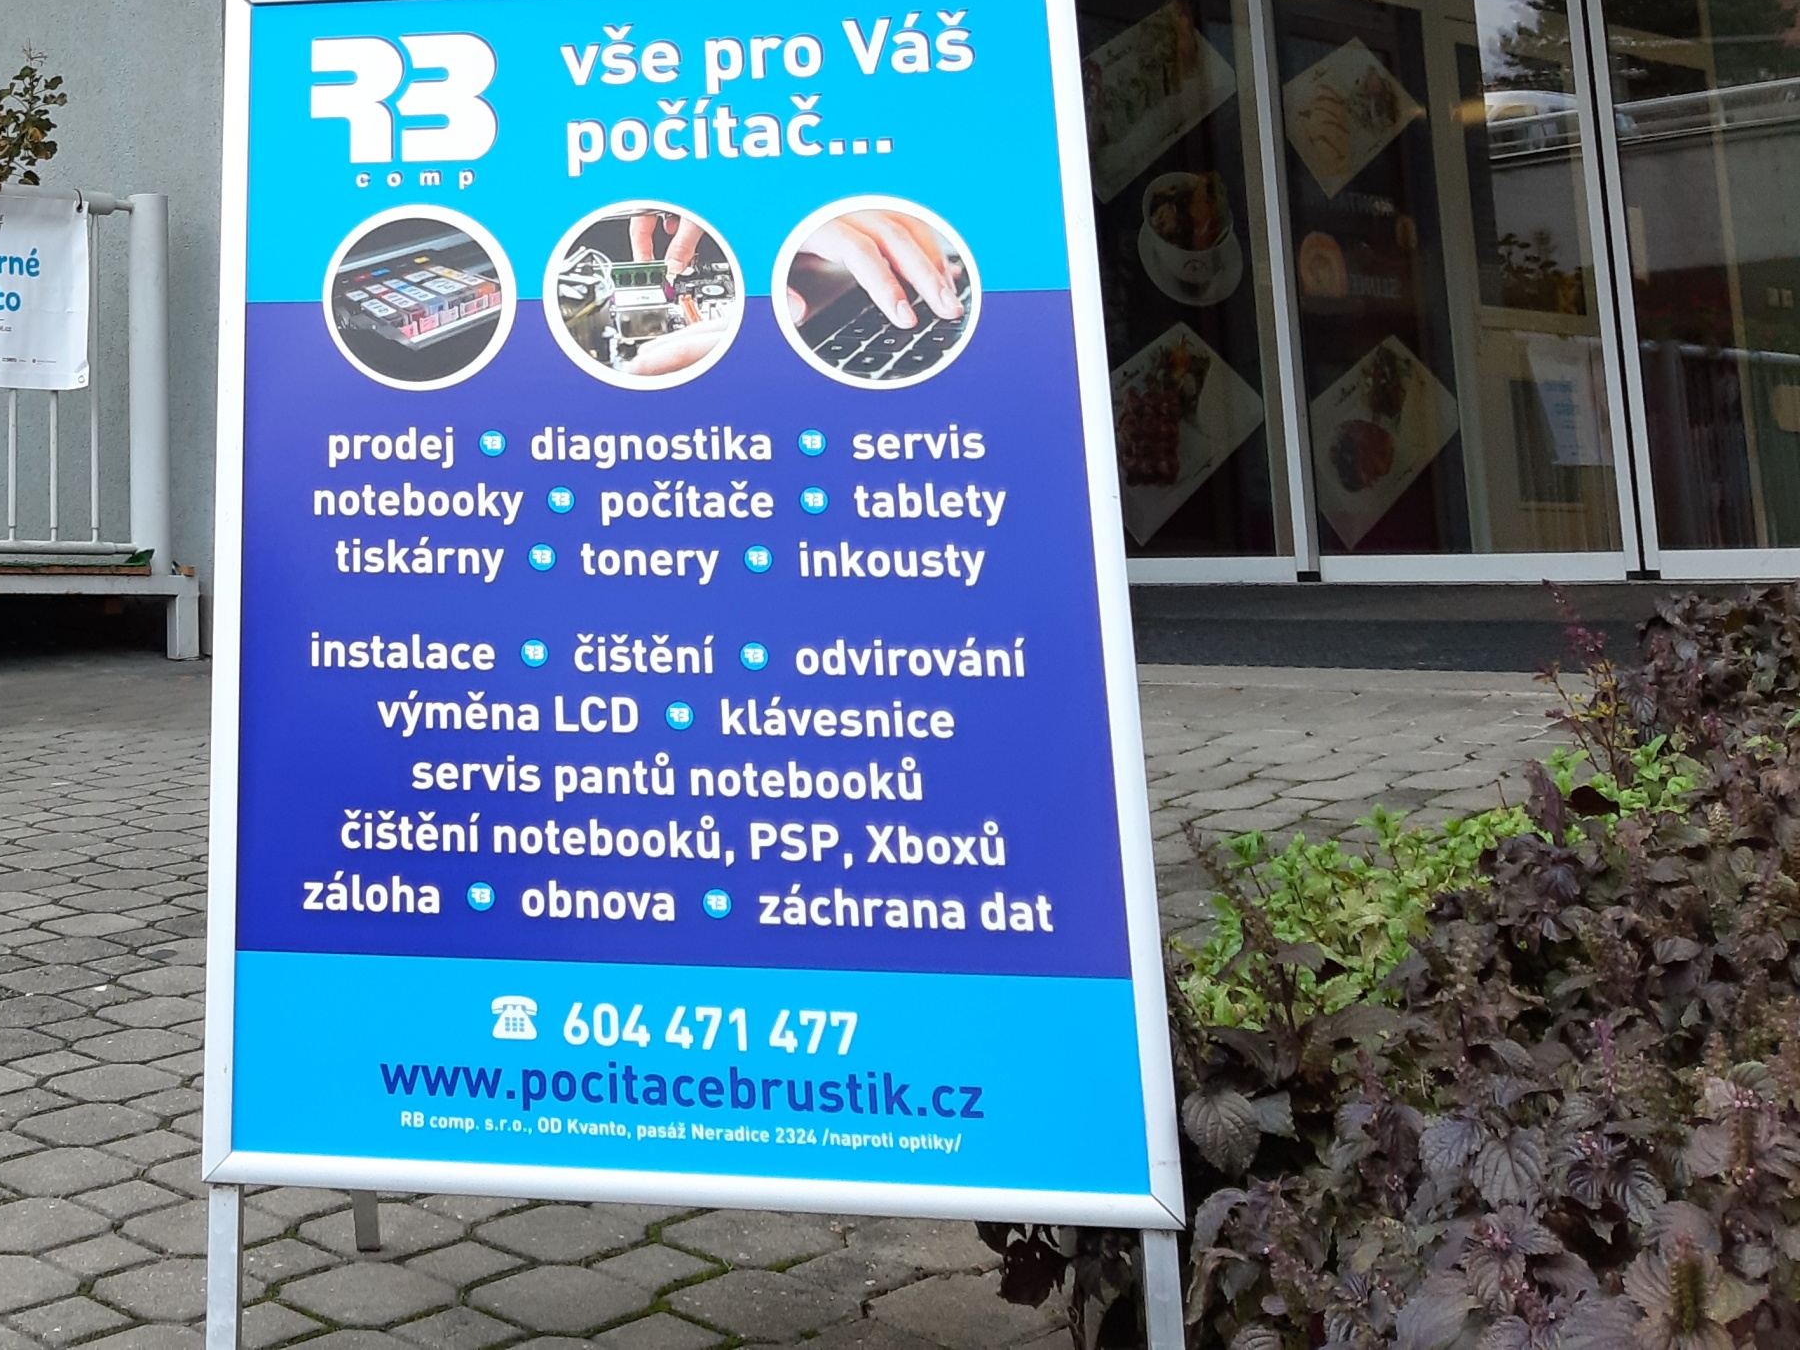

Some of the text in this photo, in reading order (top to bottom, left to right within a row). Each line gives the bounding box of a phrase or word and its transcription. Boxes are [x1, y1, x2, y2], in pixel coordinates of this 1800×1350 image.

[561, 9, 976, 95] vše pro Váš
[566, 91, 894, 177] počítač...
[355, 168, 476, 190] comp
[327, 426, 455, 470] prodej
[530, 424, 773, 470] diagnostika
[851, 424, 986, 461] servis
[313, 482, 524, 527] notebooky
[600, 479, 775, 527] počítače
[854, 483, 1007, 527] tablety
[335, 536, 505, 583] tiskárny
[580, 546, 720, 585] tonery
[798, 541, 986, 586] inkousty
[309, 633, 496, 673] instalace
[574, 632, 715, 677] čištění
[795, 635, 1026, 681] odvirování
[377, 688, 542, 738] výměna
[553, 695, 640, 735] LCD
[720, 698, 956, 741] klávesnice
[411, 752, 924, 805] servis pantů notebooků
[341, 810, 1006, 870] čištění notebooků, PSP, Xboxů
[303, 873, 442, 917] záloha
[521, 883, 676, 924] obnova
[759, 889, 966, 932] záchrana
[980, 892, 1055, 934] dat
[563, 1001, 859, 1056] 604 471 477
[380, 1061, 986, 1119] www.pocitacebrustik.cz
[401, 1111, 962, 1155] RB comp. s.r.o., OD Kvanto, pasáž Neradice 2324 /naproti optiky/
